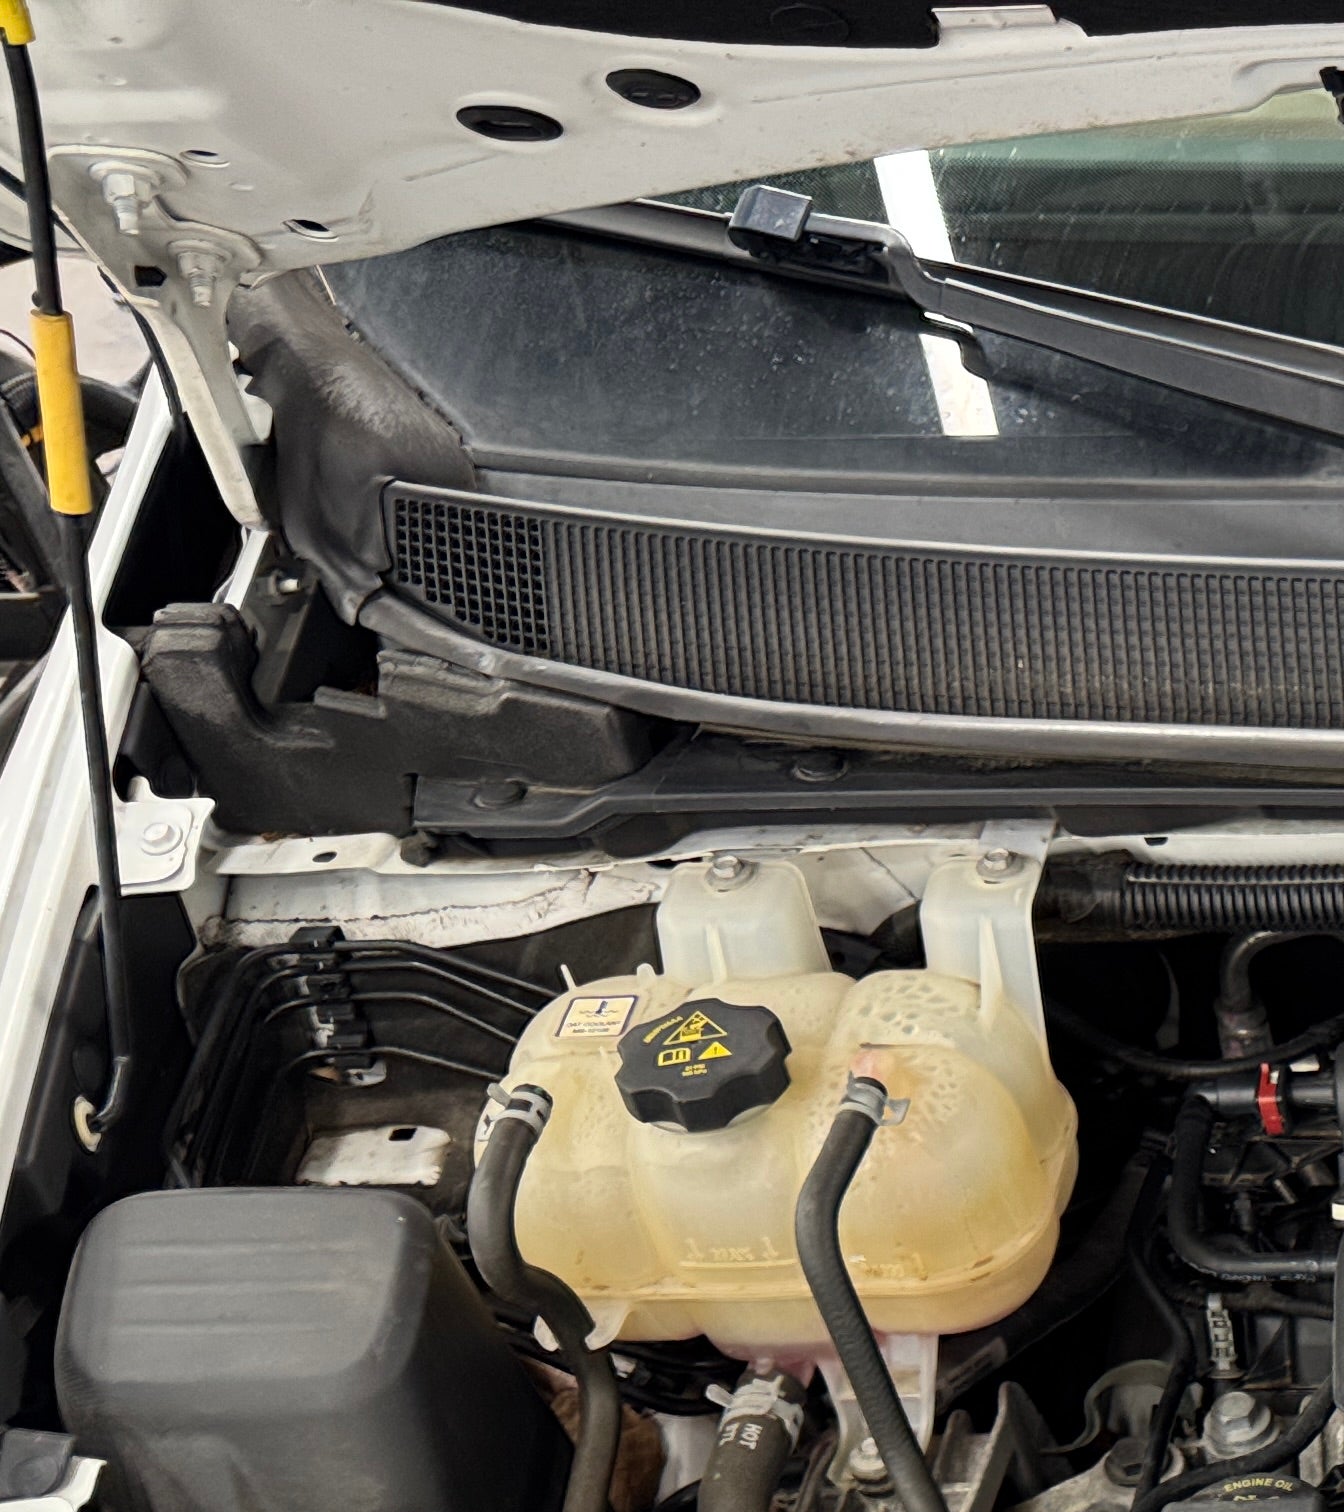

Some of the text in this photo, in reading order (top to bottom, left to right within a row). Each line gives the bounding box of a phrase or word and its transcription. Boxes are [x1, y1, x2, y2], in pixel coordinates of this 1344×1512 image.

[740, 1423, 763, 1450] HOT
[1223, 1478, 1294, 1492] ENGINE OIL
